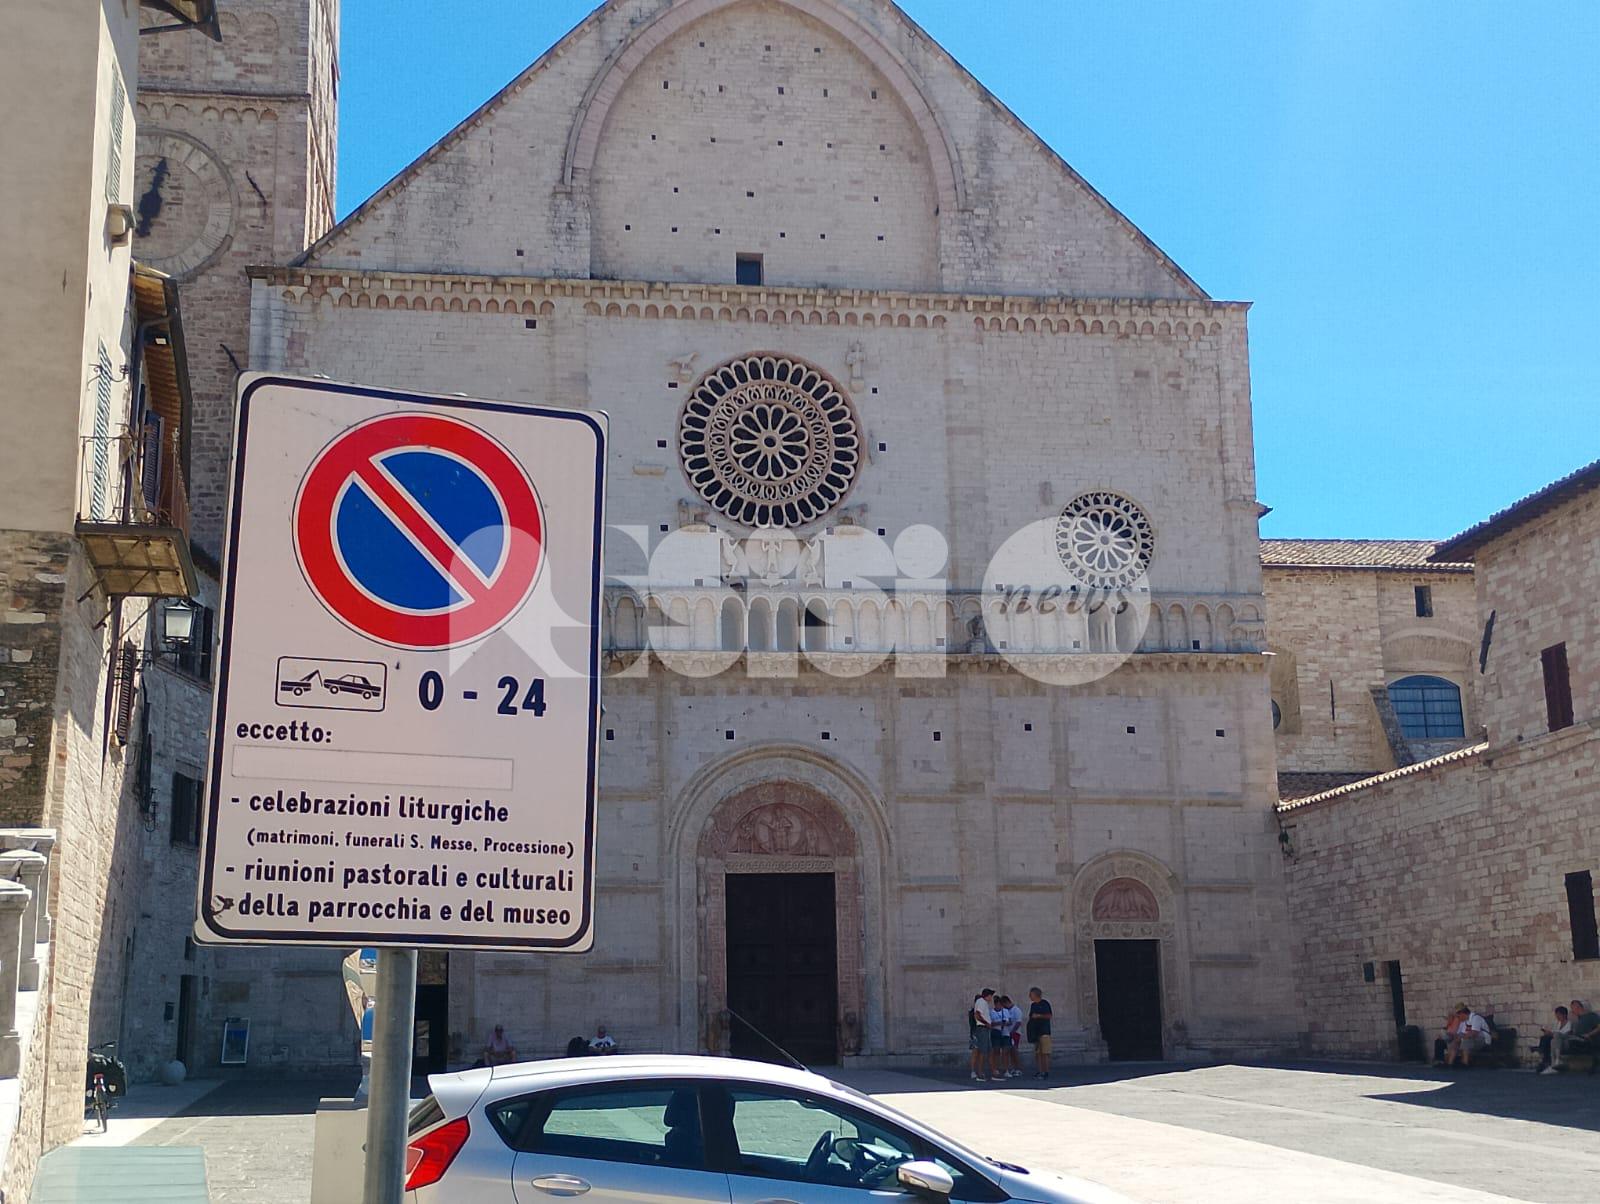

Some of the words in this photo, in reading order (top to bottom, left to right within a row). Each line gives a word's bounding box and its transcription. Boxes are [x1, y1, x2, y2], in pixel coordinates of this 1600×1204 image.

[418, 670, 444, 711] 0
[497, 675, 547, 718] 24
[236, 719, 332, 743] eccetto:
[249, 790, 390, 819] celebrazioni
[398, 795, 509, 826] liturgiche
[345, 829, 405, 849] funerali
[410, 833, 424, 850] S.
[484, 837, 574, 860] Processione)
[244, 859, 335, 884] riunioni
[343, 863, 448, 890] pastorali
[455, 871, 468, 888] e
[475, 866, 575, 892] culturali
[238, 892, 300, 918] della
[308, 896, 431, 923] parrocchia
[439, 904, 453, 921] e
[460, 898, 495, 923] del
[503, 907, 571, 926] museo
